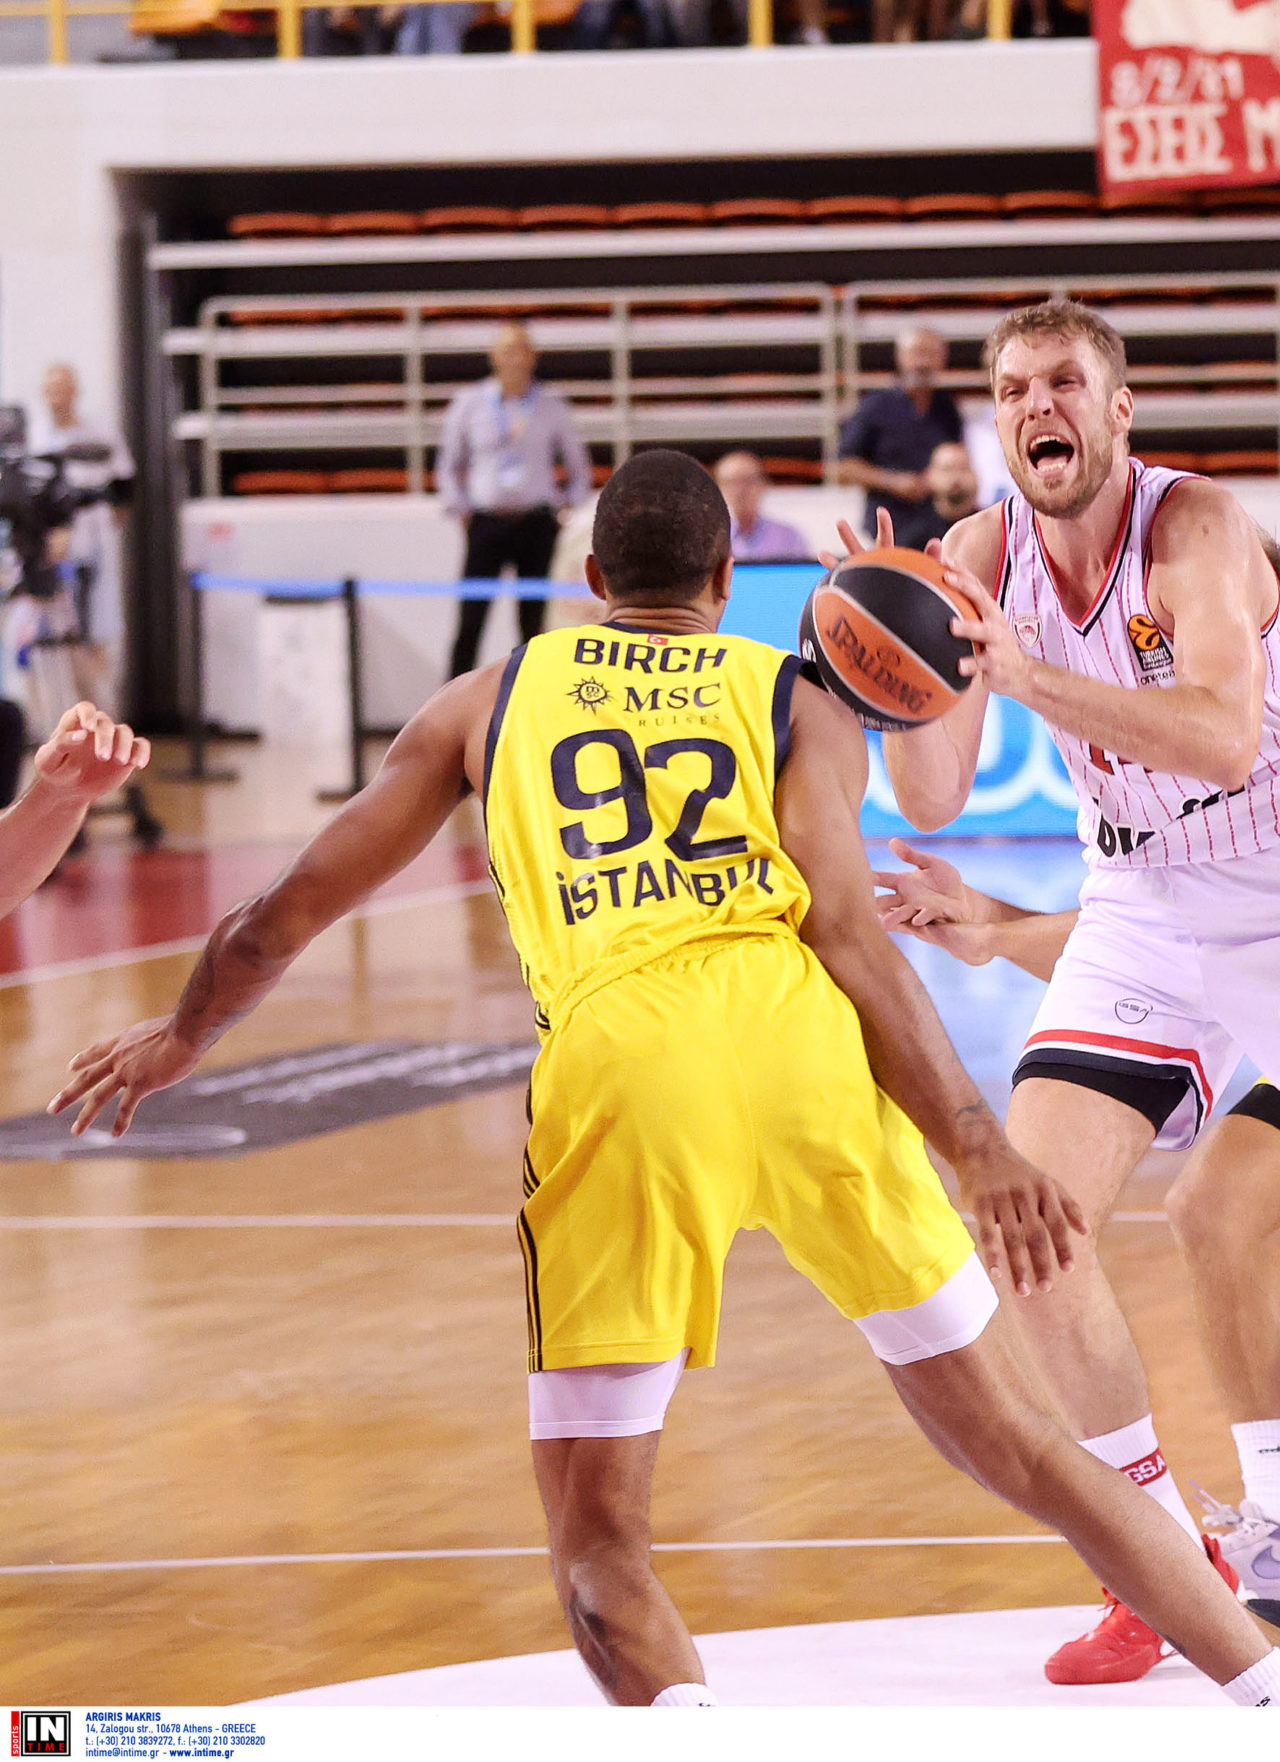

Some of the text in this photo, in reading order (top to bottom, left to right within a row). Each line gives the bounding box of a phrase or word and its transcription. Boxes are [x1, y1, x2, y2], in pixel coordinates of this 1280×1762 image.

[573, 637, 727, 674] BIRCH
[623, 682, 721, 713] MSC
[550, 728, 749, 861] 92
